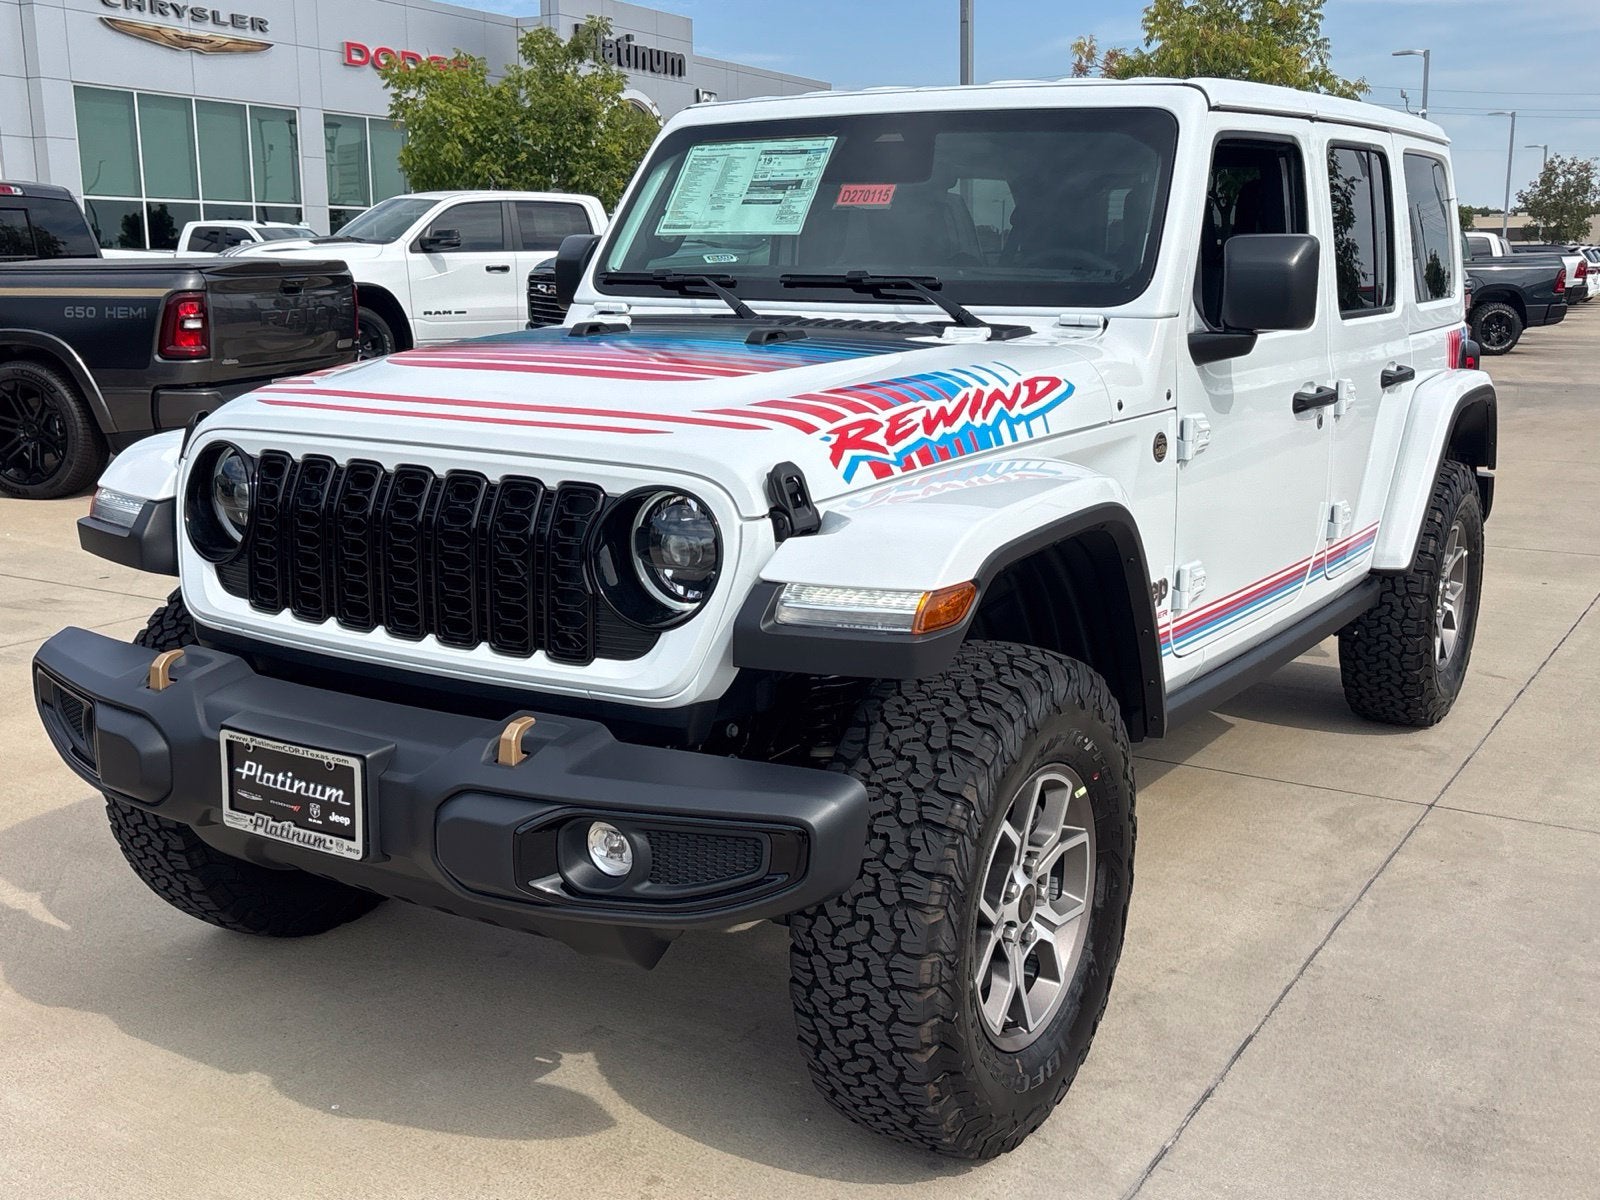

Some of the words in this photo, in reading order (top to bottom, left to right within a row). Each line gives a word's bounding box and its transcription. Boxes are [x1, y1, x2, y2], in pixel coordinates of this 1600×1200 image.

[841, 189, 892, 203] D270115
[64, 306, 96, 319] 650
[105, 306, 147, 319] HEMI
[826, 376, 1063, 470] REWIND
[228, 733, 350, 765] www.PlatinumCDRJTexas.com
[235, 760, 351, 806] Platinum
[329, 812, 351, 827] Jeep
[252, 815, 333, 851] Platinum
[345, 845, 361, 856] Jeep
